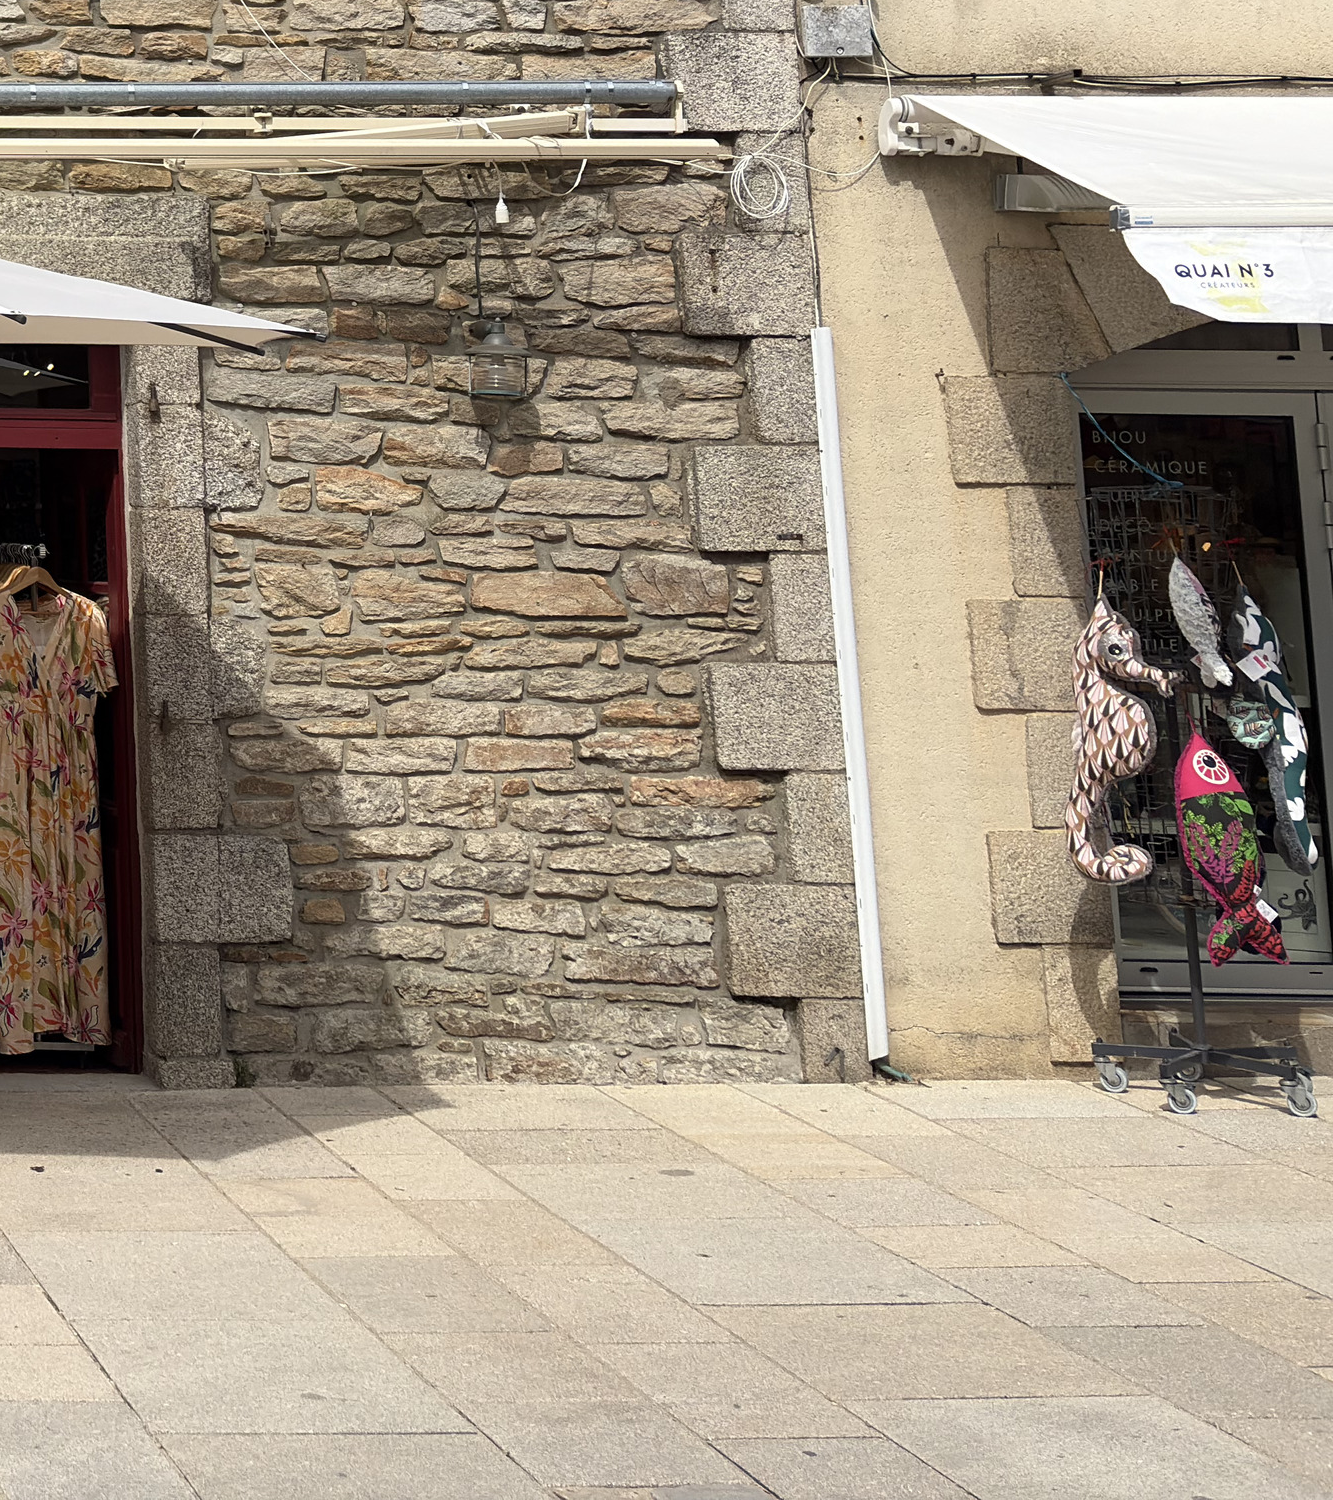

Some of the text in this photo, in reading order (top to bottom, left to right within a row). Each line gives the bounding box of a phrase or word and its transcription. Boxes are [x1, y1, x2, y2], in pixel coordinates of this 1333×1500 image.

[1174, 263, 1230, 279] QUAI
[1092, 430, 1146, 444] BIJOU
[1095, 456, 1208, 475] CÉRAMIQUE
